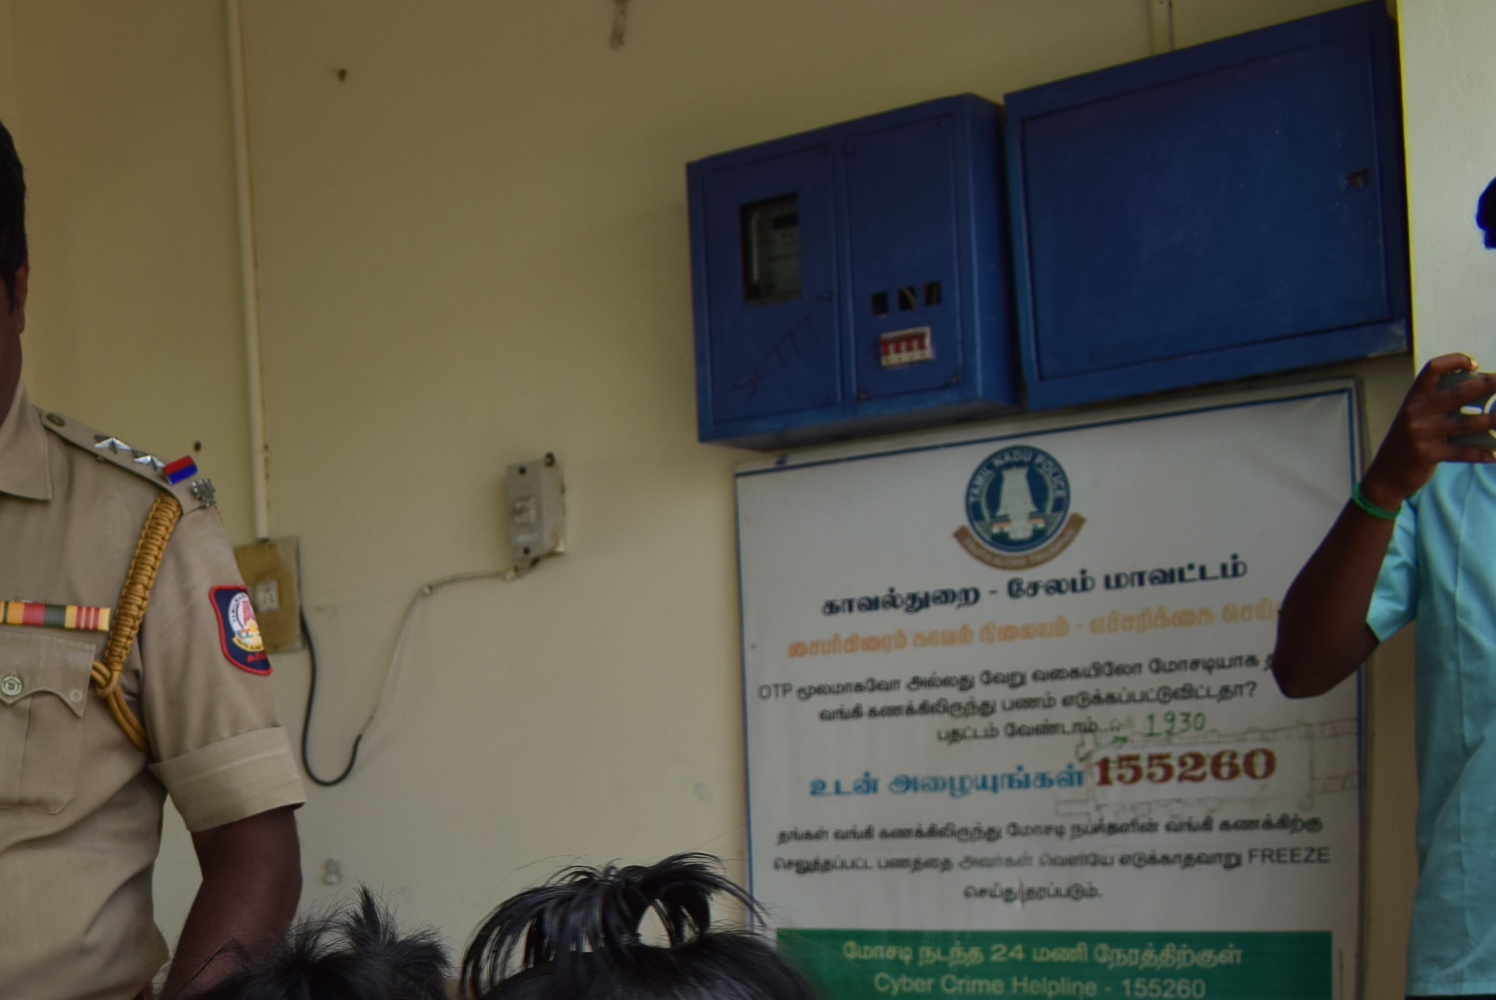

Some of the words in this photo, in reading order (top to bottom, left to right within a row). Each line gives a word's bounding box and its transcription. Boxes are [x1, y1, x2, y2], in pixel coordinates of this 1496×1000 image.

[969, 466, 995, 502] TAMIL
[992, 450, 1034, 469] NADU
[1033, 455, 1067, 498] POLICE
[822, 586, 980, 615] காவல்துறை
[1007, 568, 1095, 599] சேலம்
[1104, 554, 1247, 590] மாவட்டம்
[758, 683, 792, 700] OTP
[907, 672, 975, 692] அல்லது
[819, 704, 863, 721] வங்கி
[1145, 710, 1207, 737] 1930
[810, 770, 879, 797] உடன்
[888, 762, 1084, 798] அழையுங்கள்
[1095, 748, 1277, 786] 155260
[776, 826, 829, 846] தங்கள்
[833, 824, 874, 840] வங்கி
[1248, 847, 1332, 865] FREEZE
[991, 944, 1025, 962] 24
[1032, 942, 1088, 962] மணி
[874, 973, 933, 997] Cyber
[940, 974, 1004, 993] Crime
[1012, 975, 1097, 999] Helpline
[1122, 977, 1206, 998] 155260
